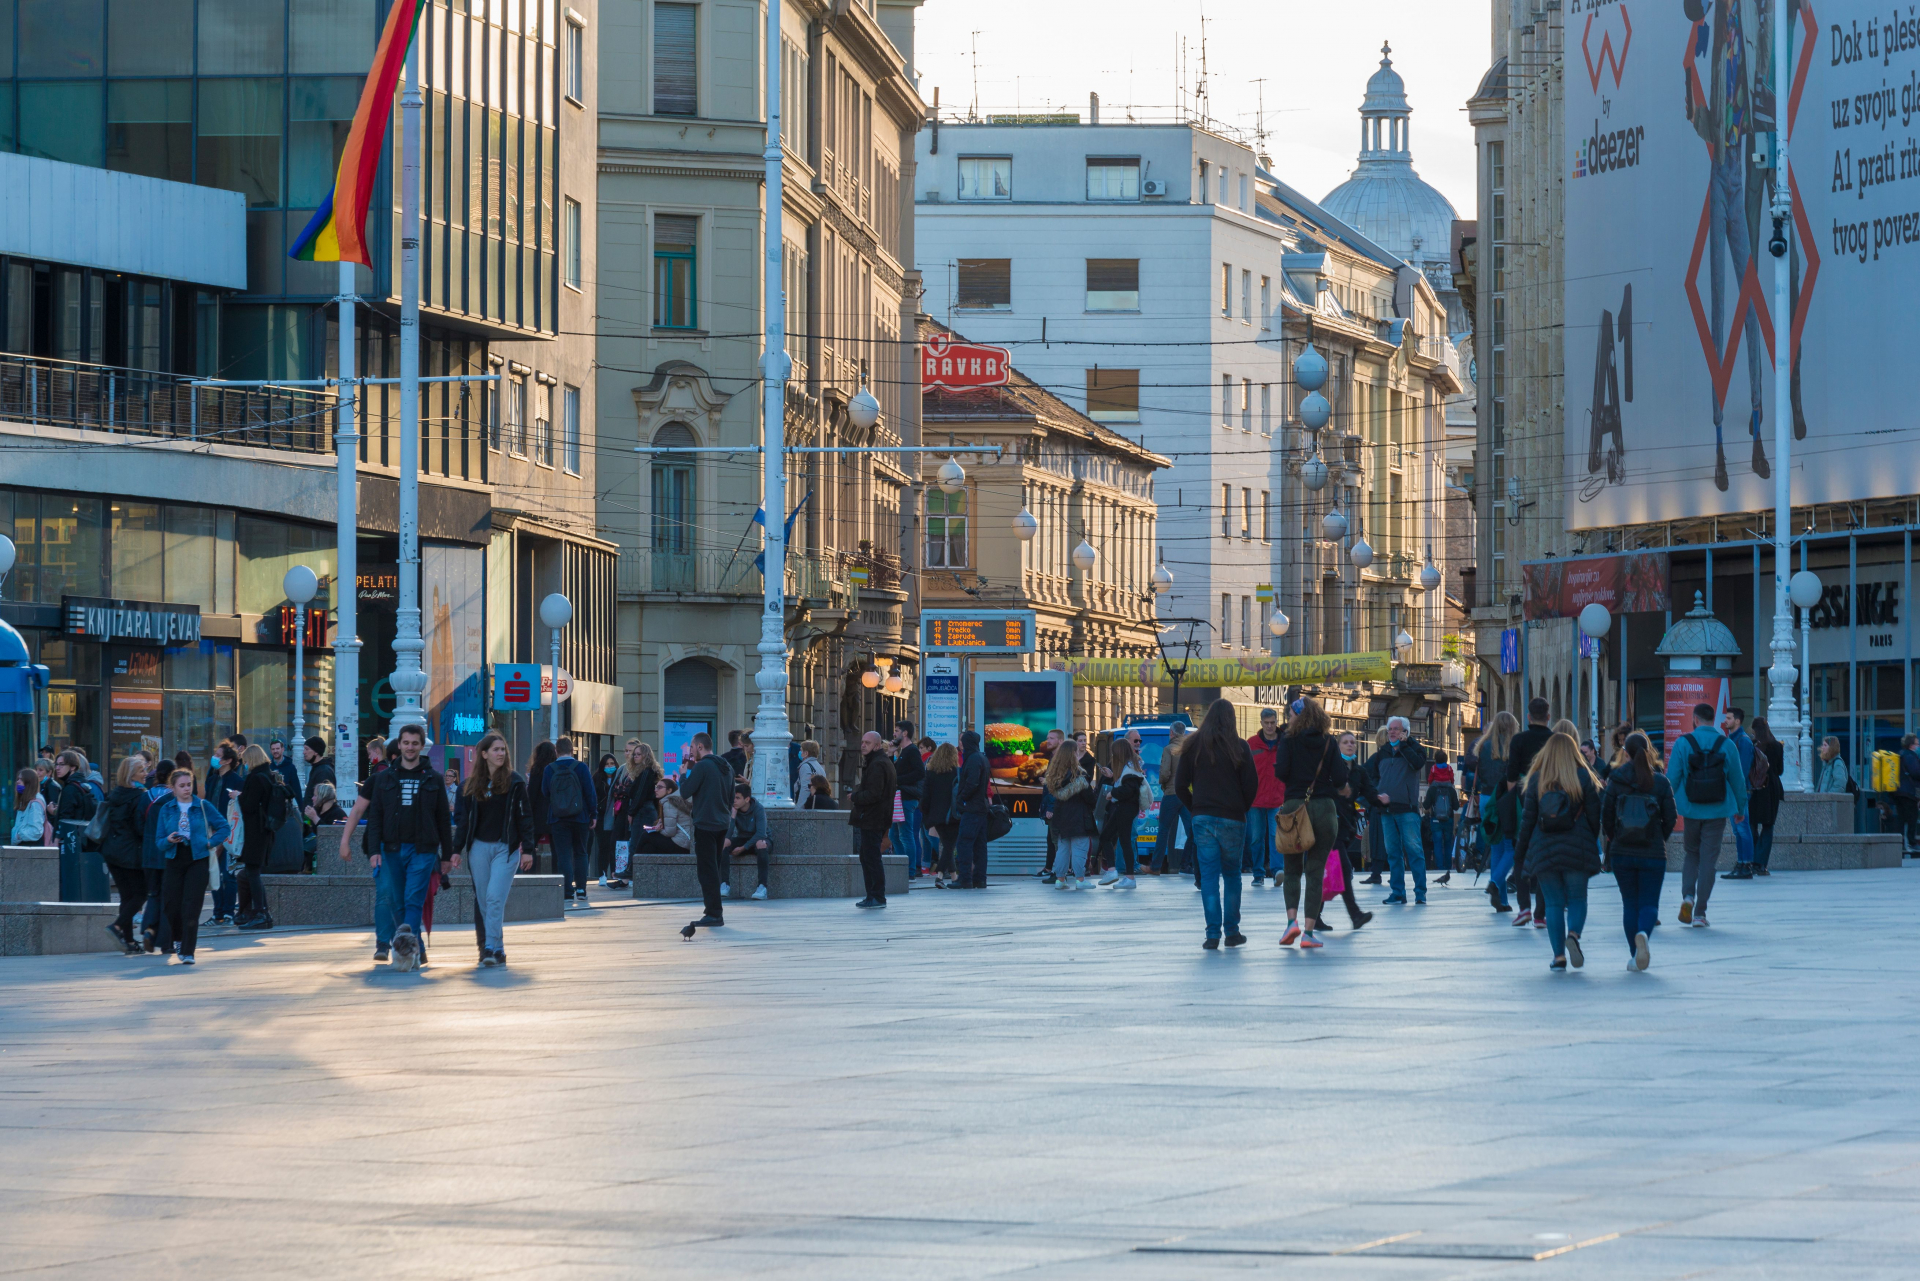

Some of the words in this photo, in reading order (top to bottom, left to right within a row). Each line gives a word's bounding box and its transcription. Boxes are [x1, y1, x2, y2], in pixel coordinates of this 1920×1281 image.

[1831, 20, 1862, 67] Dok
[1867, 16, 1878, 58] ti
[1602, 95, 1611, 119] by
[1831, 98, 1849, 129] uz
[1854, 78, 1896, 131] svoju
[1588, 118, 1645, 175] deezer
[1831, 147, 1852, 193] A1
[1858, 140, 1895, 200] prati
[1900, 136, 1920, 179] rit
[1833, 217, 1868, 264] tvog
[356, 575, 397, 588] PELATI
[88, 600, 152, 642] KNJIŽARA
[157, 612, 202, 645] LJEVAK
[1869, 634, 1893, 647] PARIS
[541, 677, 567, 687] Fres
[1069, 662, 1157, 682] ANIMAFEST
[1682, 684, 1704, 692] ATRIUM
